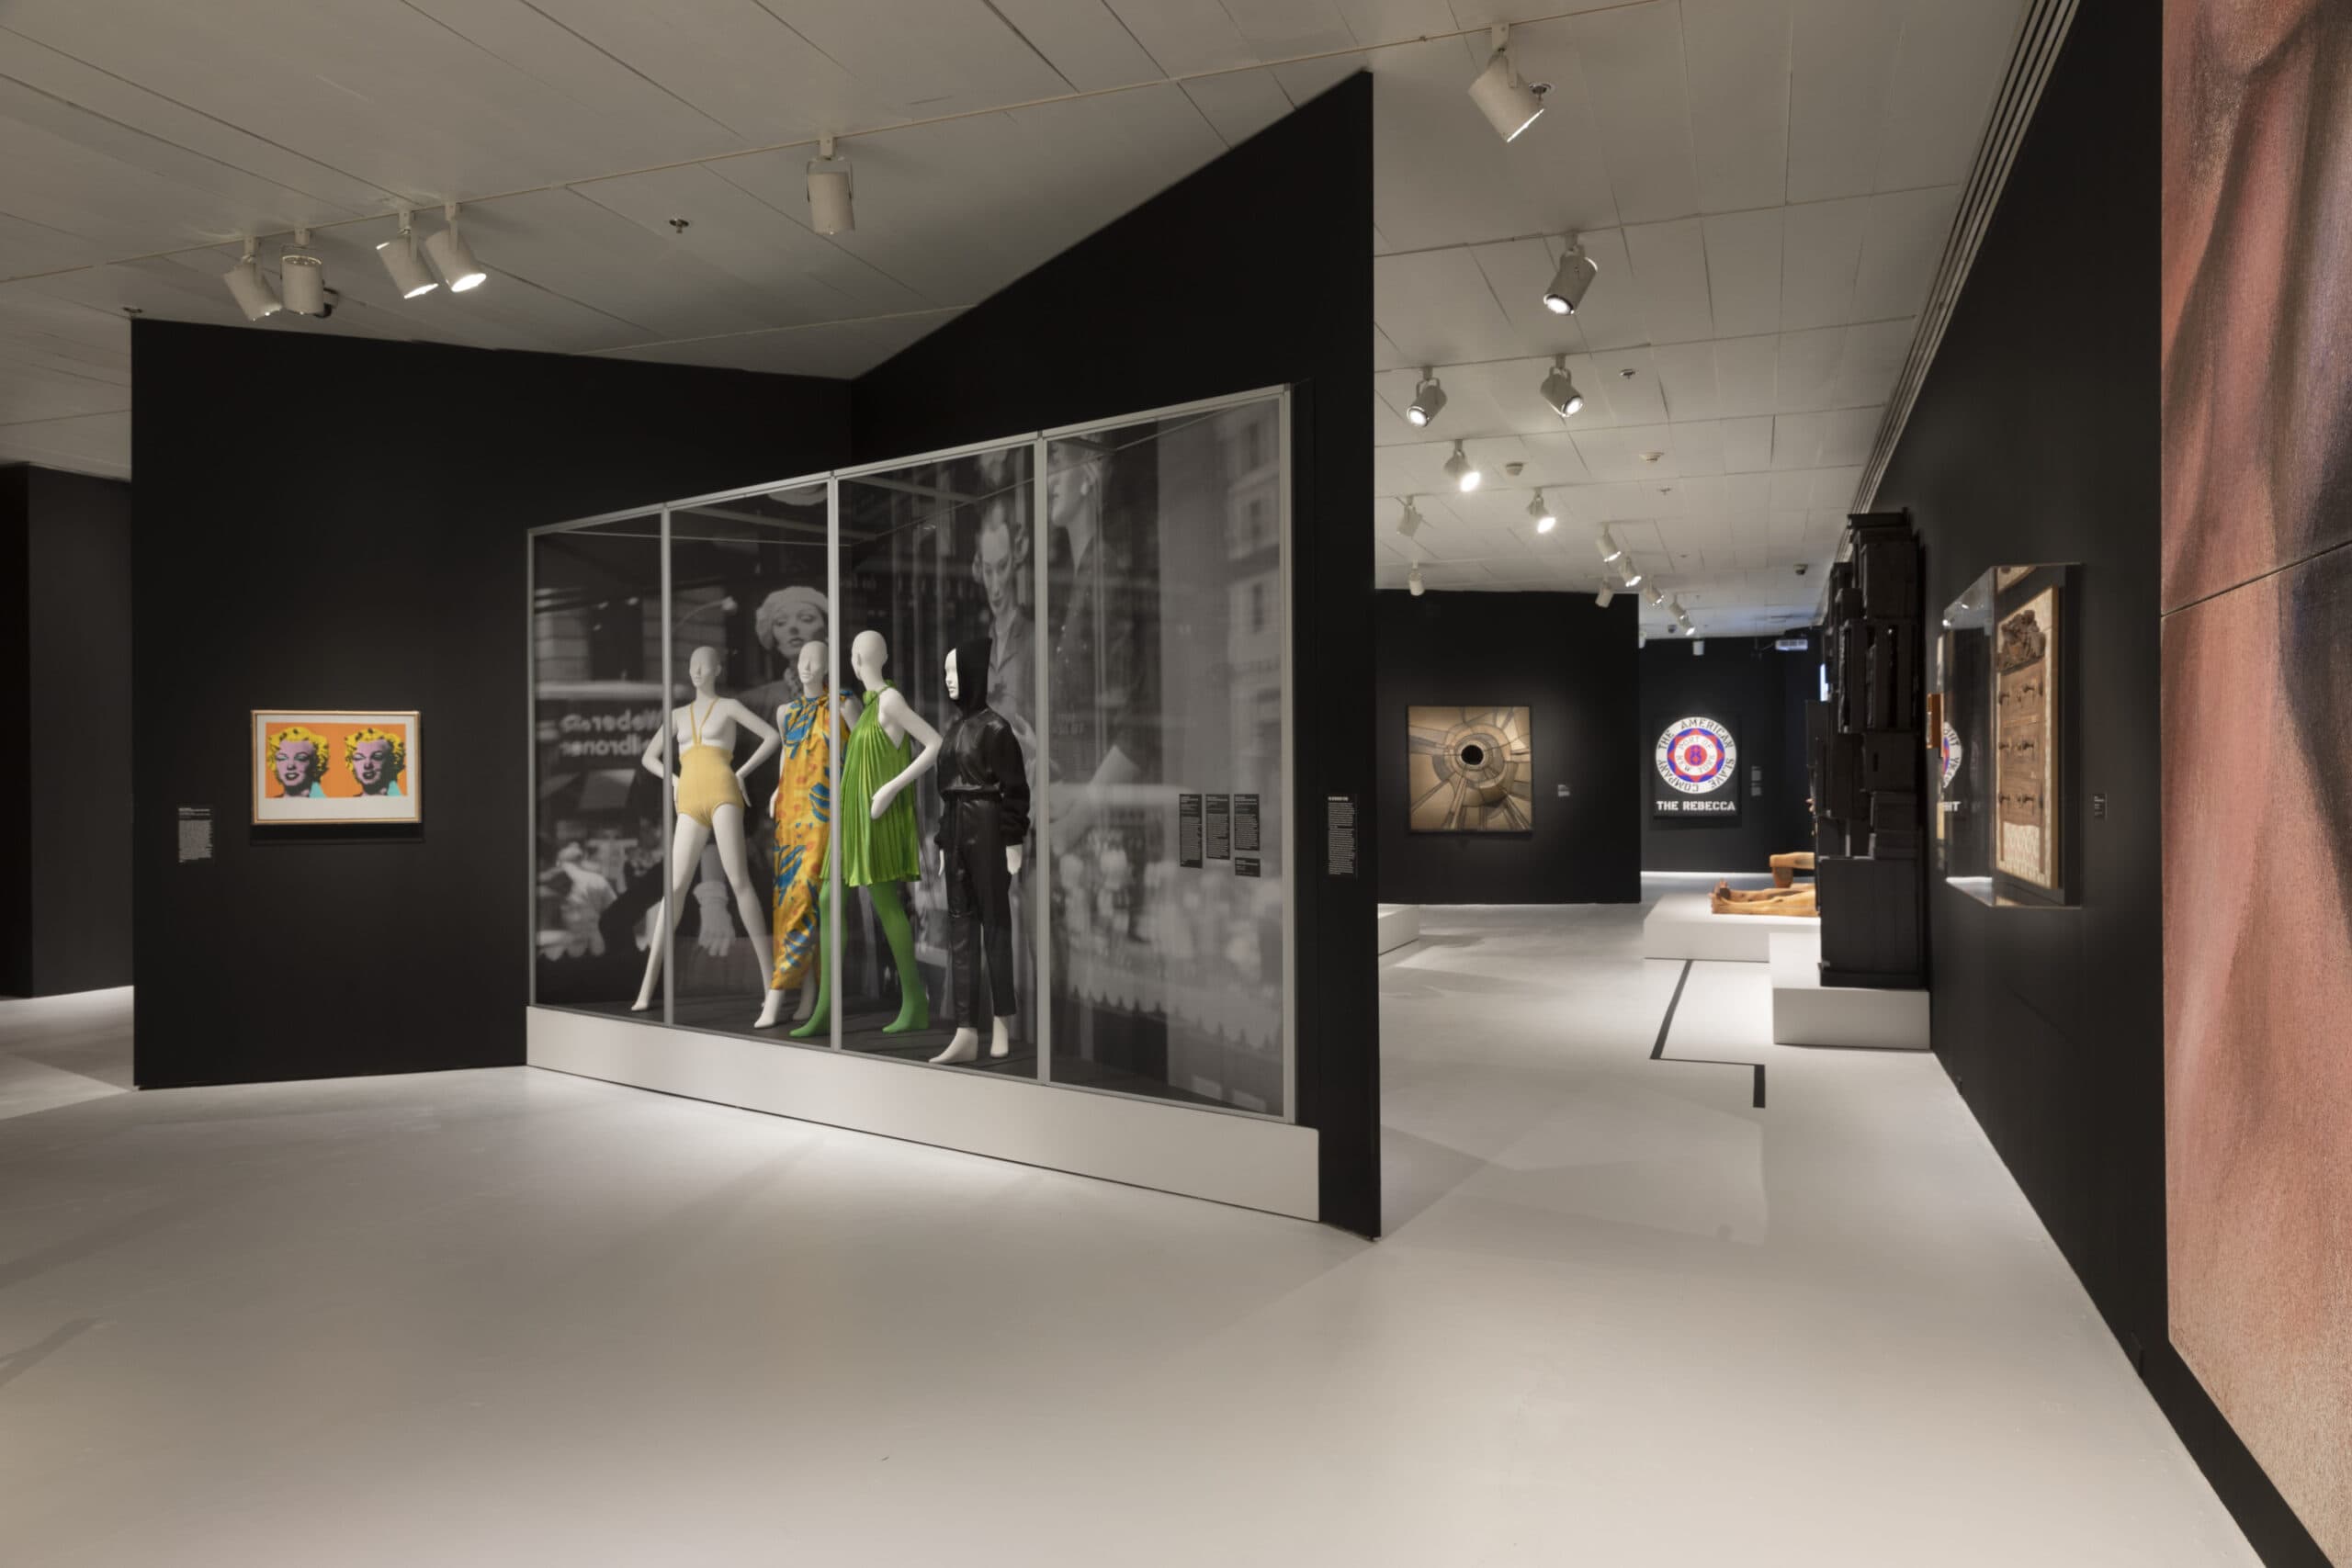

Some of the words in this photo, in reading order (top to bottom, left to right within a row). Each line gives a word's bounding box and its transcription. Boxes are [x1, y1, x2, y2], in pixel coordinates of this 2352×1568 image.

[1657, 729, 1674, 750] THE
[1680, 718, 1735, 749] AMERICAN
[1657, 759, 1700, 792] COMPANY
[1708, 758, 1736, 788] SLAVE
[1657, 800, 1679, 811] THE
[1682, 800, 1736, 811] REBECCA
